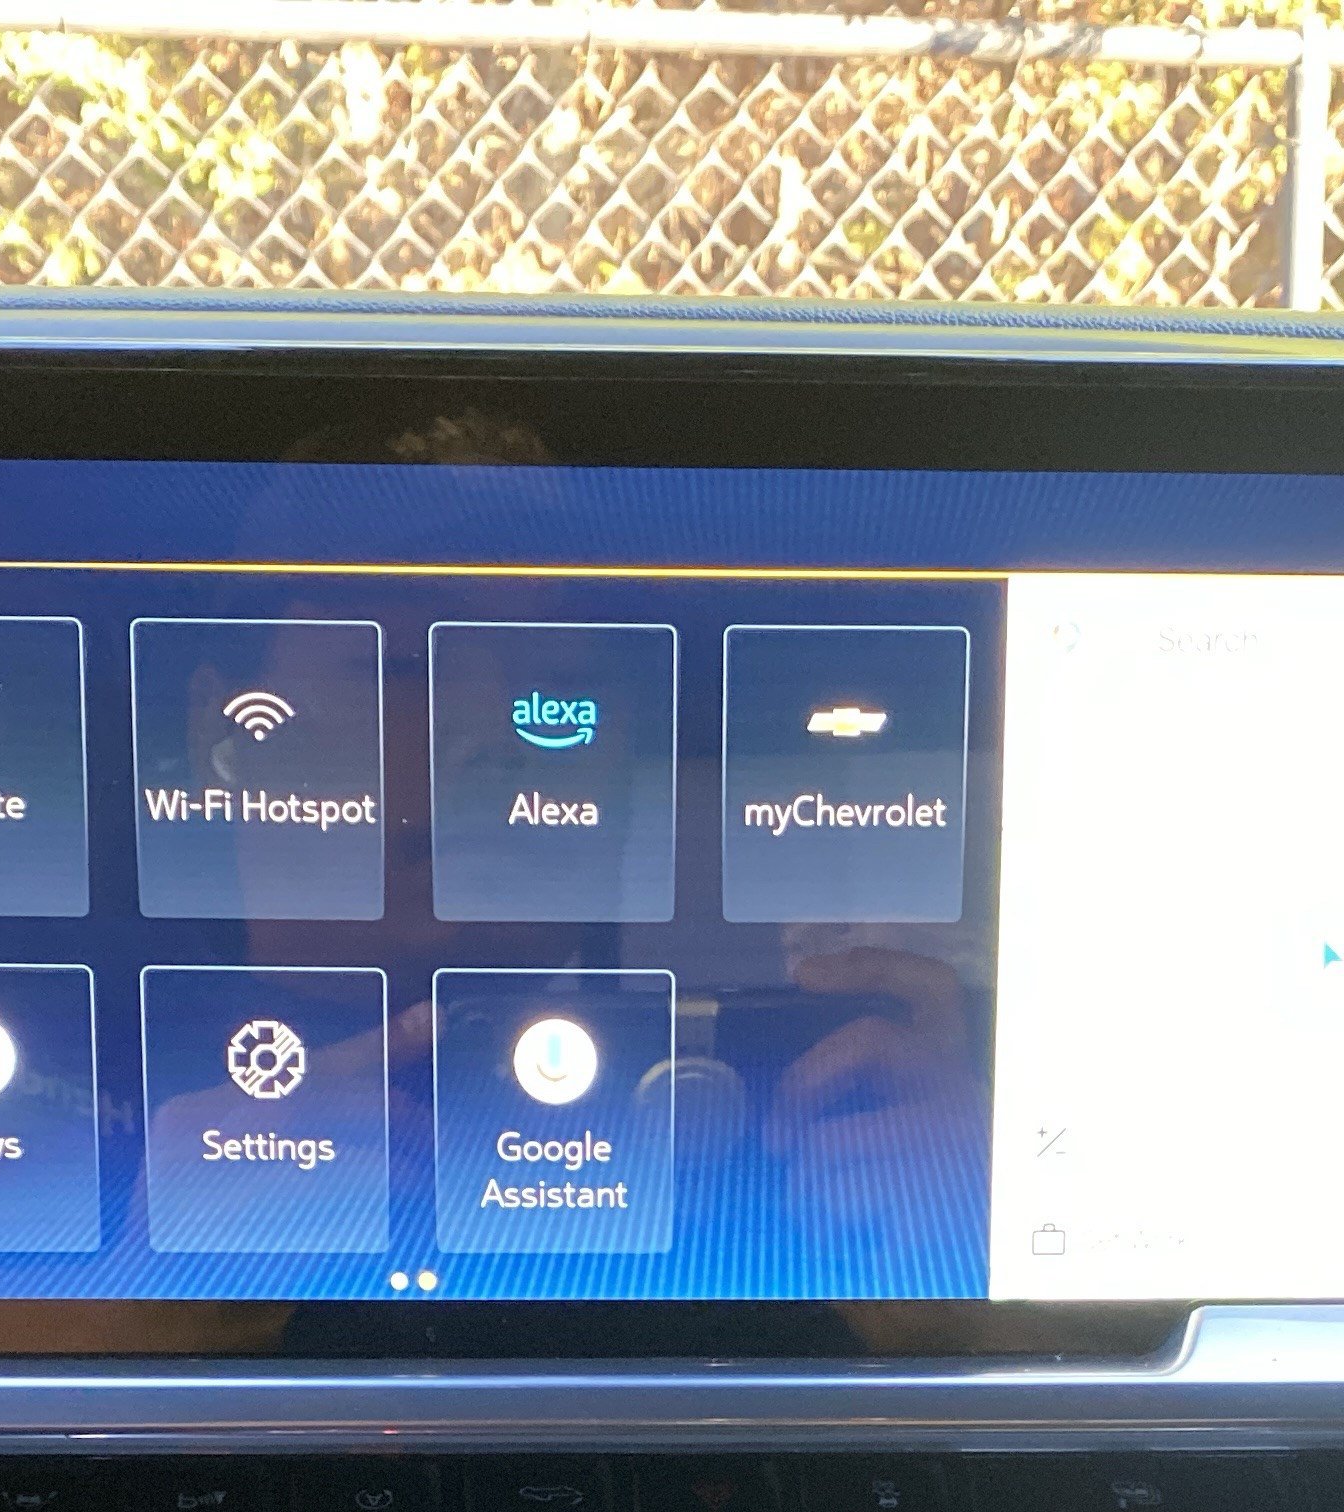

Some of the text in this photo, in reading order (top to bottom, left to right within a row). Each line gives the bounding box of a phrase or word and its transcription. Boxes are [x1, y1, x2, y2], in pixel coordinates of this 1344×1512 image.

[512, 692, 597, 726] alexa
[145, 788, 376, 831] Wi-Fi Hotspot
[508, 792, 599, 826] Alexa
[744, 793, 947, 836] myChevrolet
[202, 1130, 336, 1169] Settings
[497, 1132, 612, 1170] Google
[480, 1178, 629, 1211] Assistant
